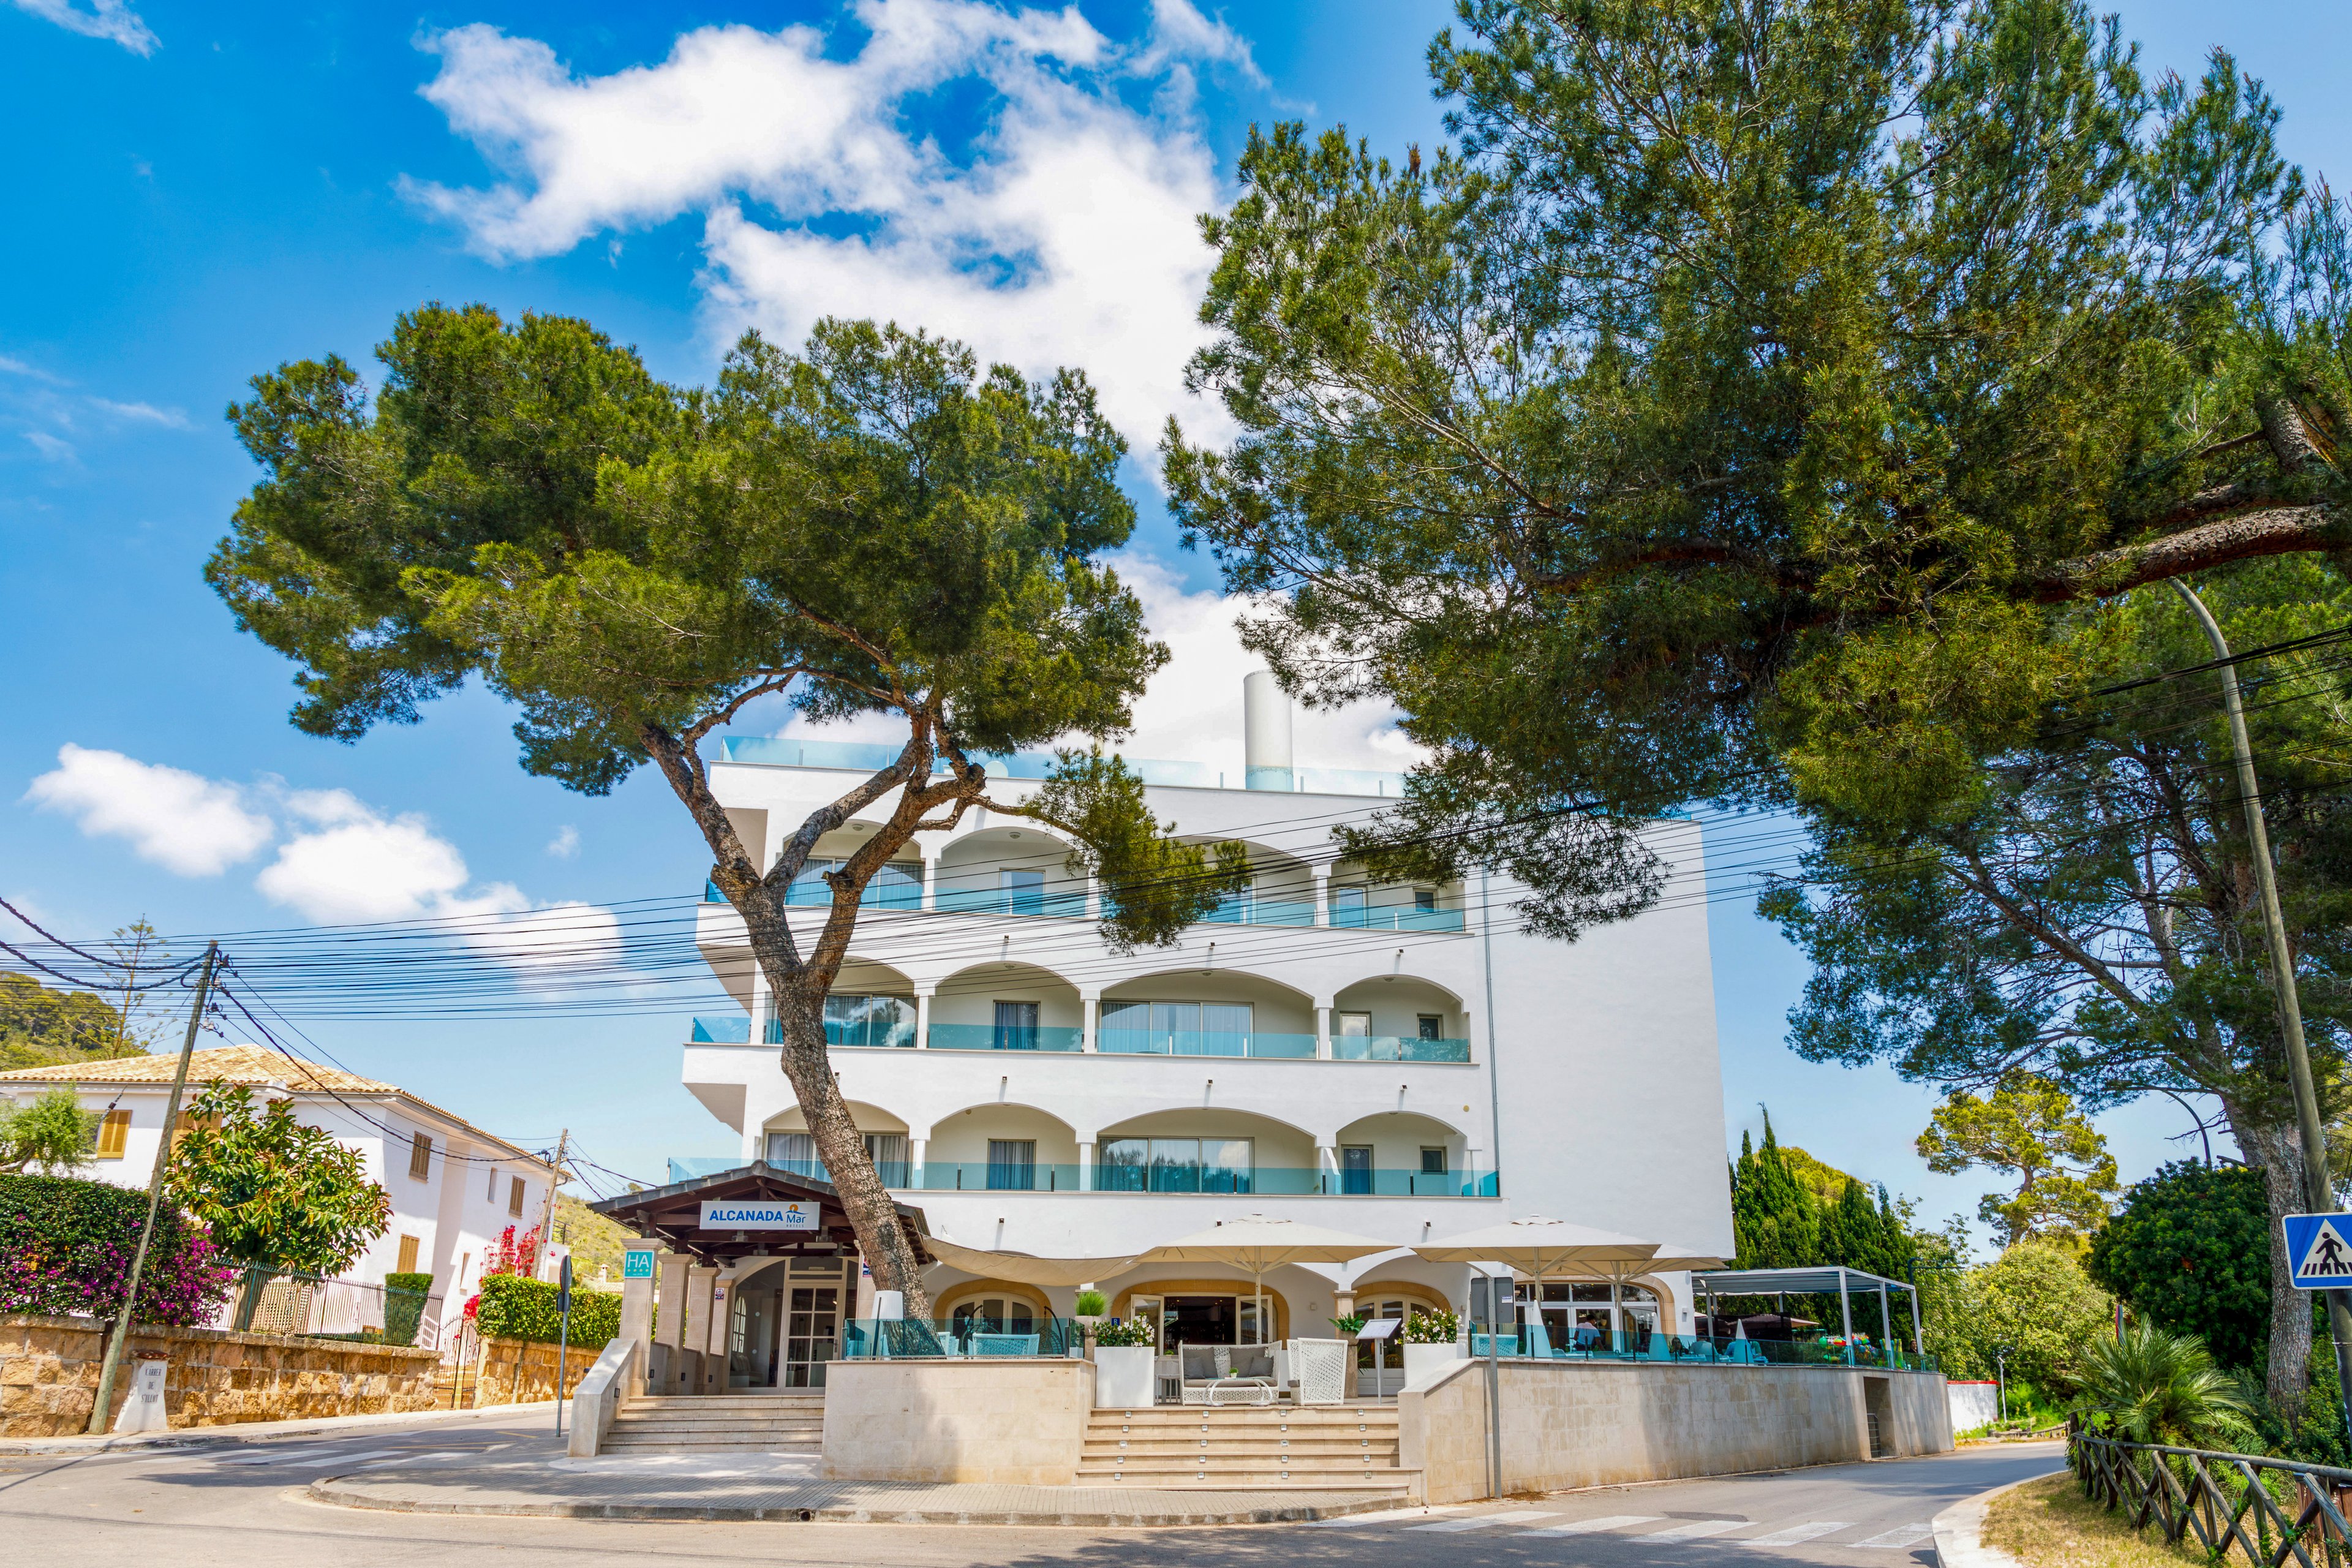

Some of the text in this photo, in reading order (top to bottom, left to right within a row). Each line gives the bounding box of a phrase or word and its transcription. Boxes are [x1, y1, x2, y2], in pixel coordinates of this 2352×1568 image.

[709, 1210, 806, 1223] ALCANADA Mar
[628, 1254, 649, 1268] HA
[148, 1381, 154, 1390] DE
